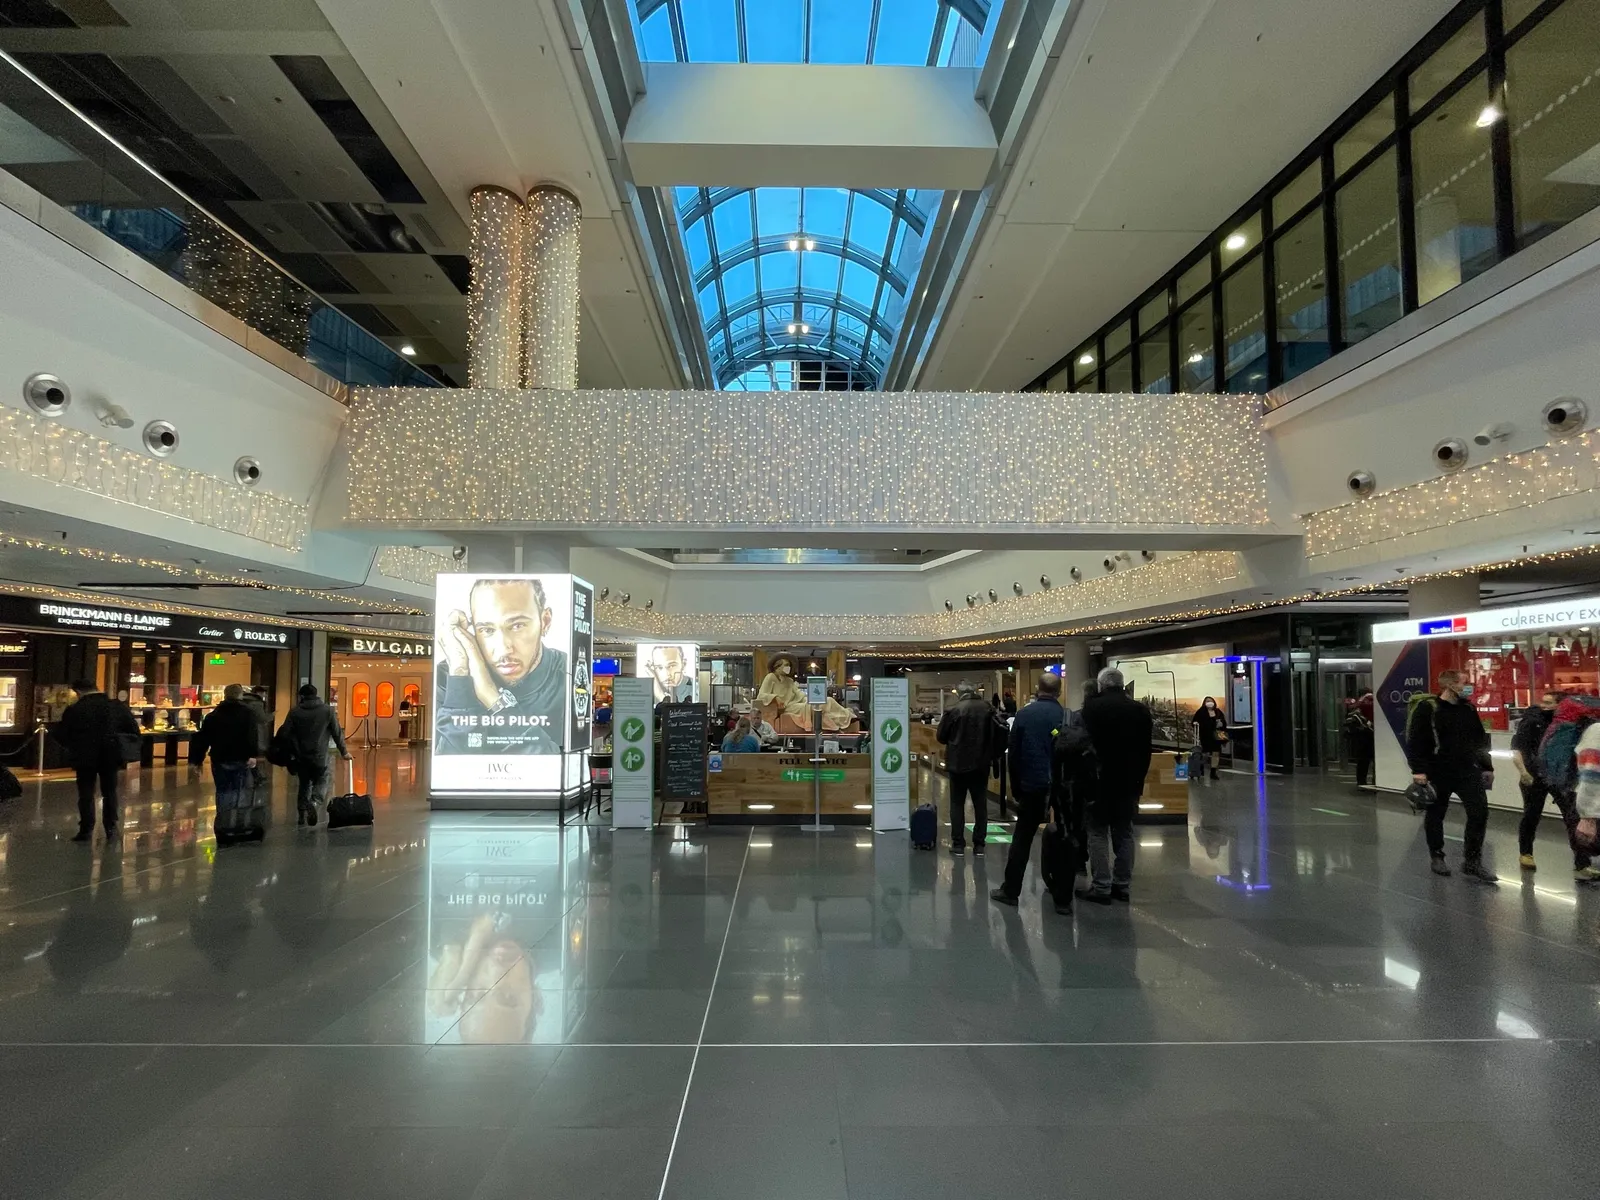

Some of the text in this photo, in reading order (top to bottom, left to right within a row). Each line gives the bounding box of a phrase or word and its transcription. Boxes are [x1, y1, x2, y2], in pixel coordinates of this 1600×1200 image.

[574, 590, 587, 607] THE
[40, 604, 170, 627] BRINCKMANN & LANGE
[574, 604, 585, 620] BIG
[1501, 608, 1600, 627] CURRENCY EX
[58, 618, 90, 626] EXQUISITE
[90, 620, 118, 628] WATCHES
[199, 627, 224, 637] Cartier
[245, 631, 277, 642] ROLEX
[353, 639, 432, 656] BVLGARI
[1404, 677, 1424, 686] ATM
[451, 715, 551, 726] THE BIG PILOT.
[488, 763, 513, 774] IWC
